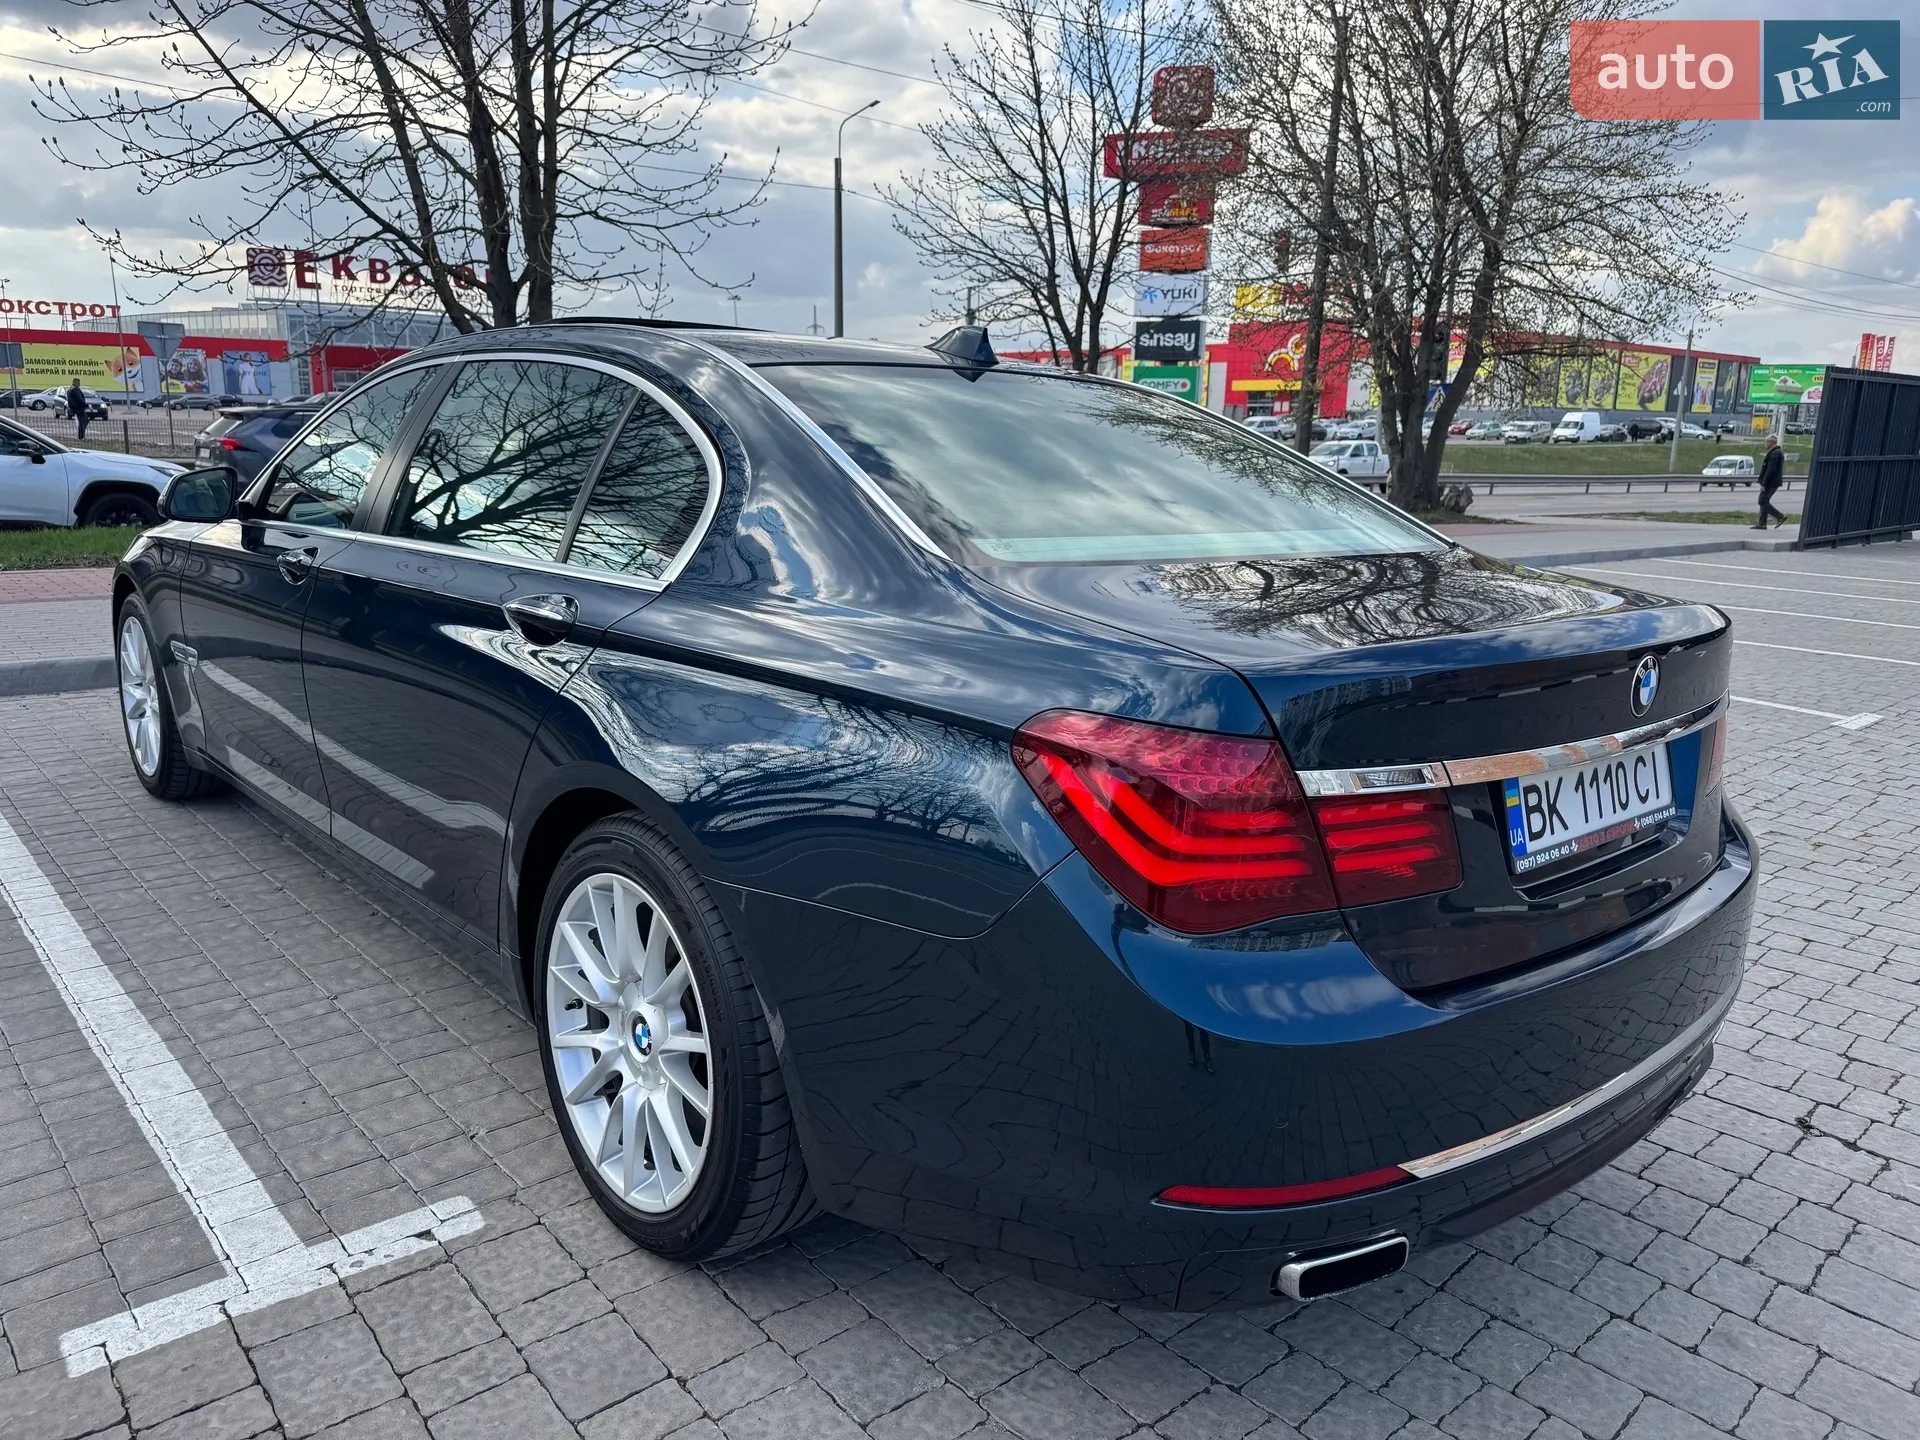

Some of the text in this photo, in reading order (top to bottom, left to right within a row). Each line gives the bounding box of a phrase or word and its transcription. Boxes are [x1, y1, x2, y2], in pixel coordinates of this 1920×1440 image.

[1161, 288, 1197, 299] YUKI
[1139, 330, 1196, 351] sinsay
[25, 358, 67, 366] ЗАМОВЛЯЙ
[26, 367, 59, 375] ЗАБИРАЙ
[1141, 381, 1180, 389] COMFY
[1522, 752, 1660, 842] BK 1110 CI
[1510, 828, 1524, 846] UA
[1517, 856, 1536, 872] (097)
[1536, 852, 1550, 863] 924
[1550, 848, 1559, 859] 06
[1560, 845, 1570, 855] 40
